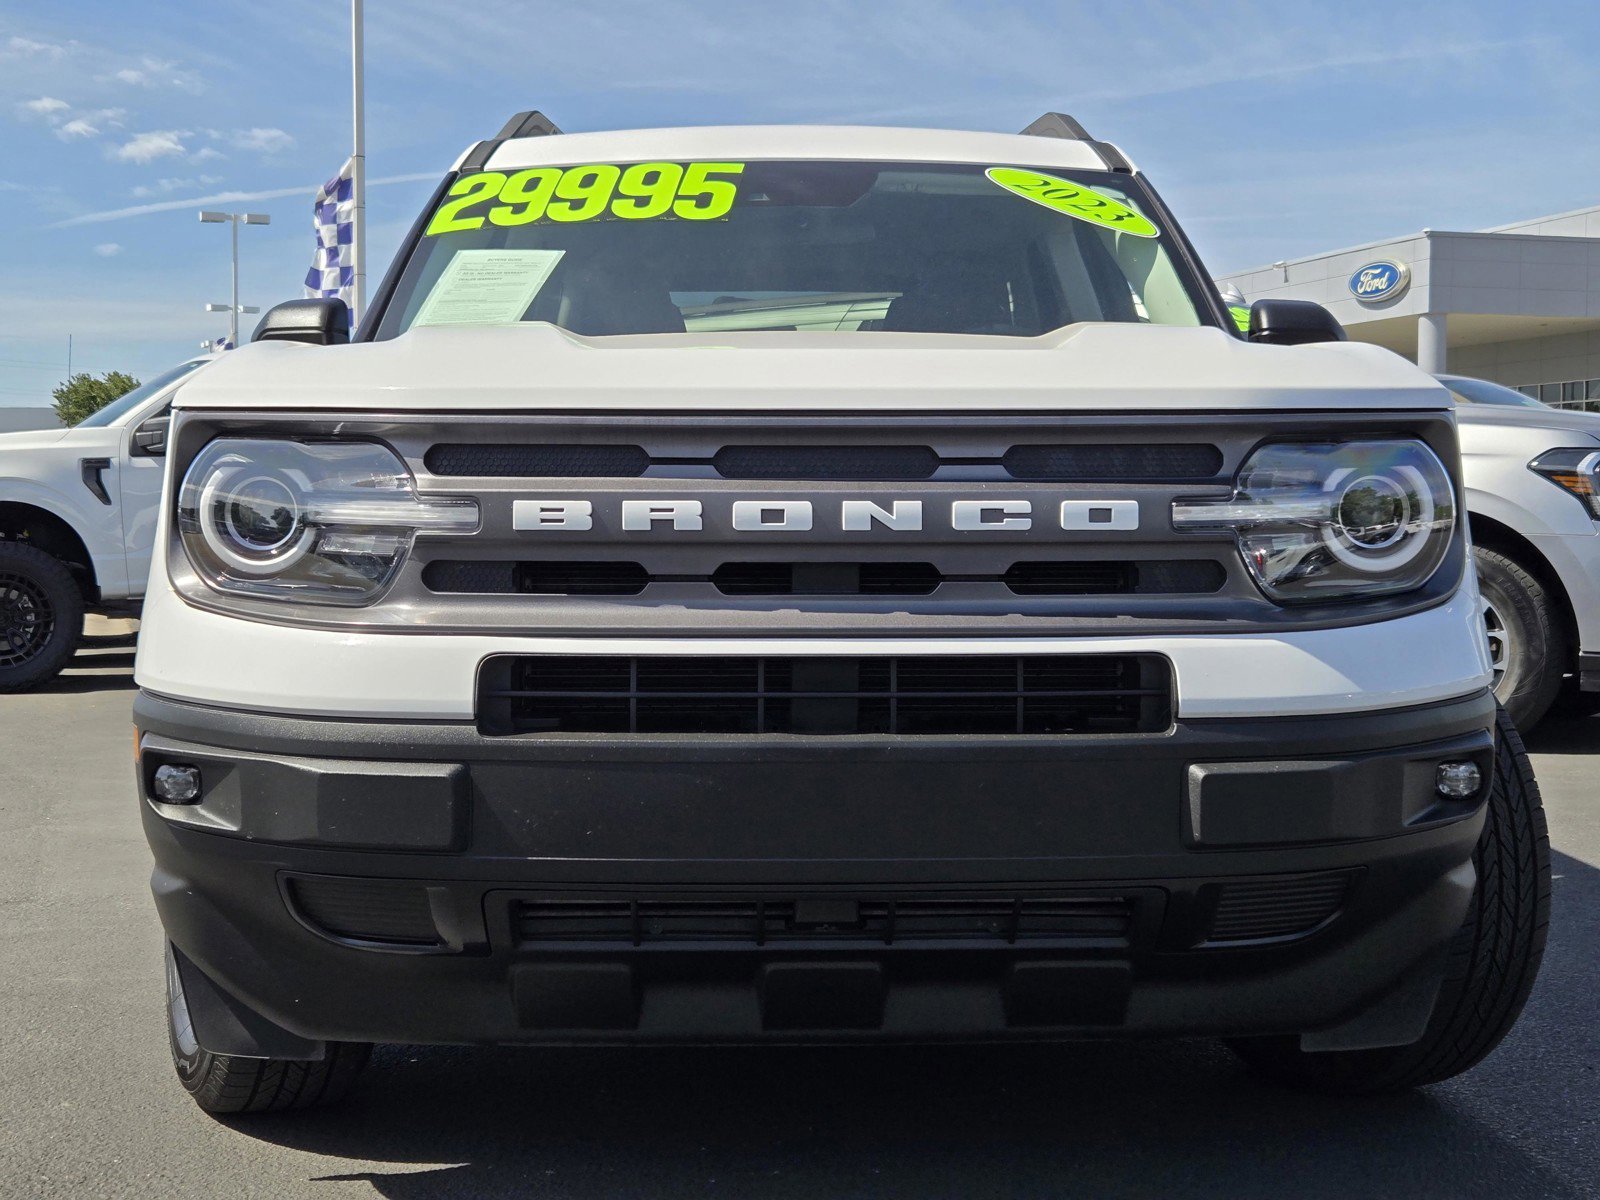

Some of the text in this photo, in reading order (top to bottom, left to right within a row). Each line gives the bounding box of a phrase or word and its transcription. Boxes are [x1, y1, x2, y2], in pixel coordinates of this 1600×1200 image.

[426, 162, 745, 236] 29995
[1013, 178, 1136, 222] 2023
[1357, 267, 1390, 294] Ford
[512, 499, 1139, 531] BRONCO
